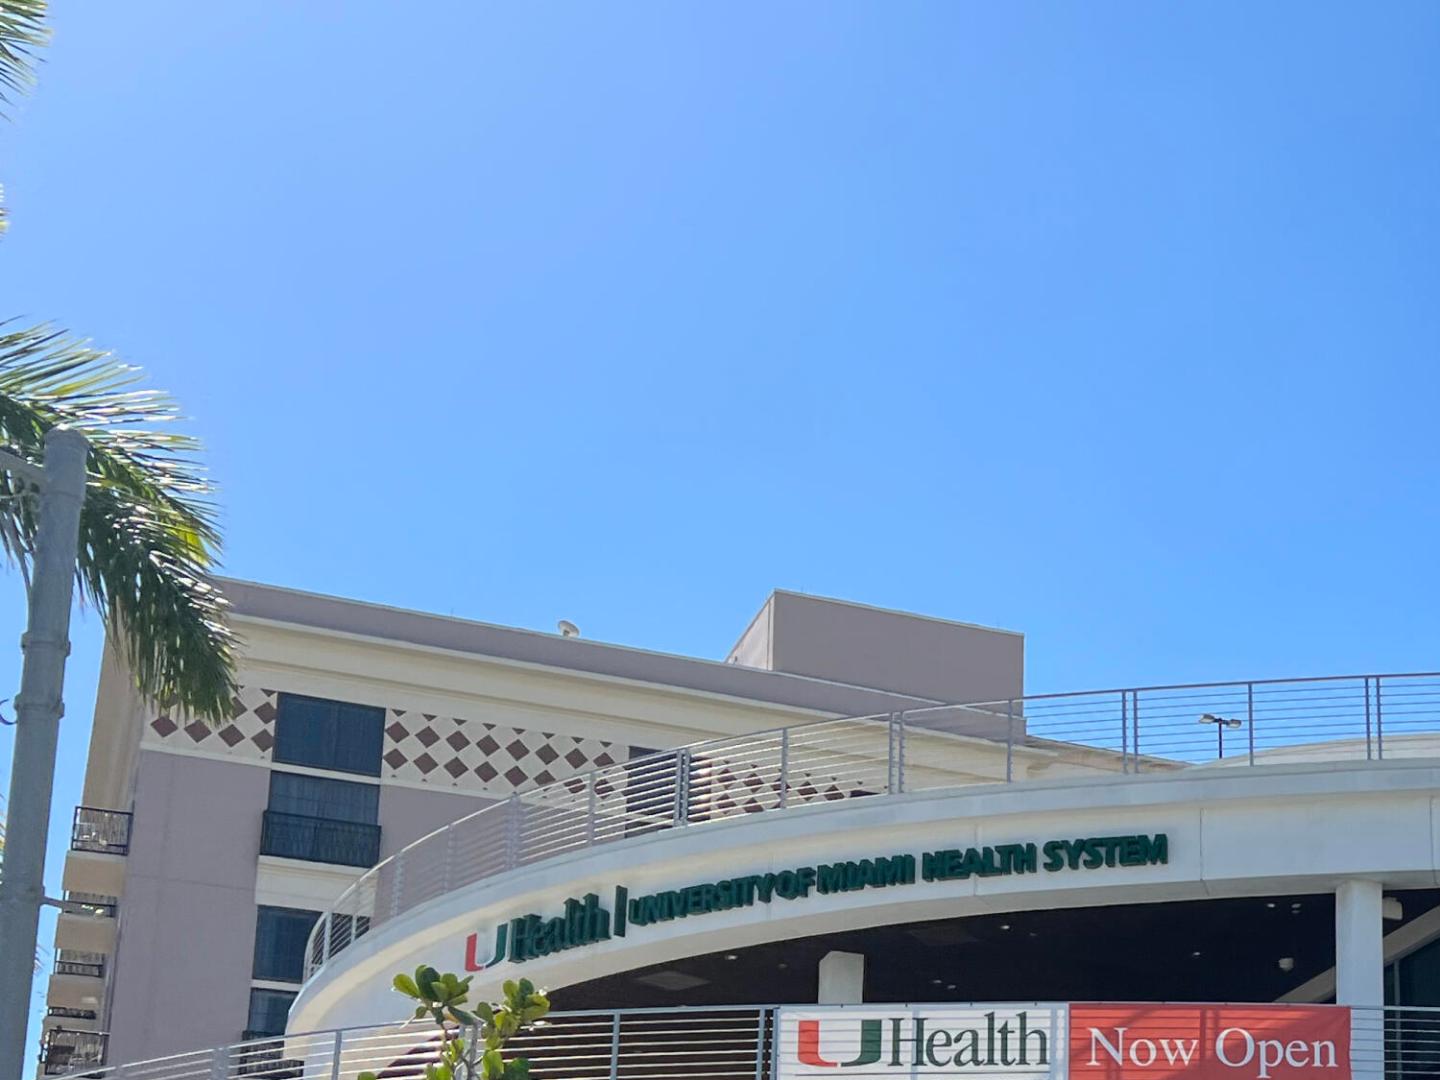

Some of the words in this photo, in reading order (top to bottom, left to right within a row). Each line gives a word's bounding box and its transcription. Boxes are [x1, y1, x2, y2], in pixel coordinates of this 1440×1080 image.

[628, 873, 775, 926] UNIVERSITY
[775, 867, 817, 900] OF
[817, 854, 916, 895] MIAMI
[922, 842, 1038, 882] HEALTH
[1043, 833, 1169, 872] SYSTEM
[1086, 1027, 1199, 1067] Now
[1214, 1027, 1339, 1079] Open
